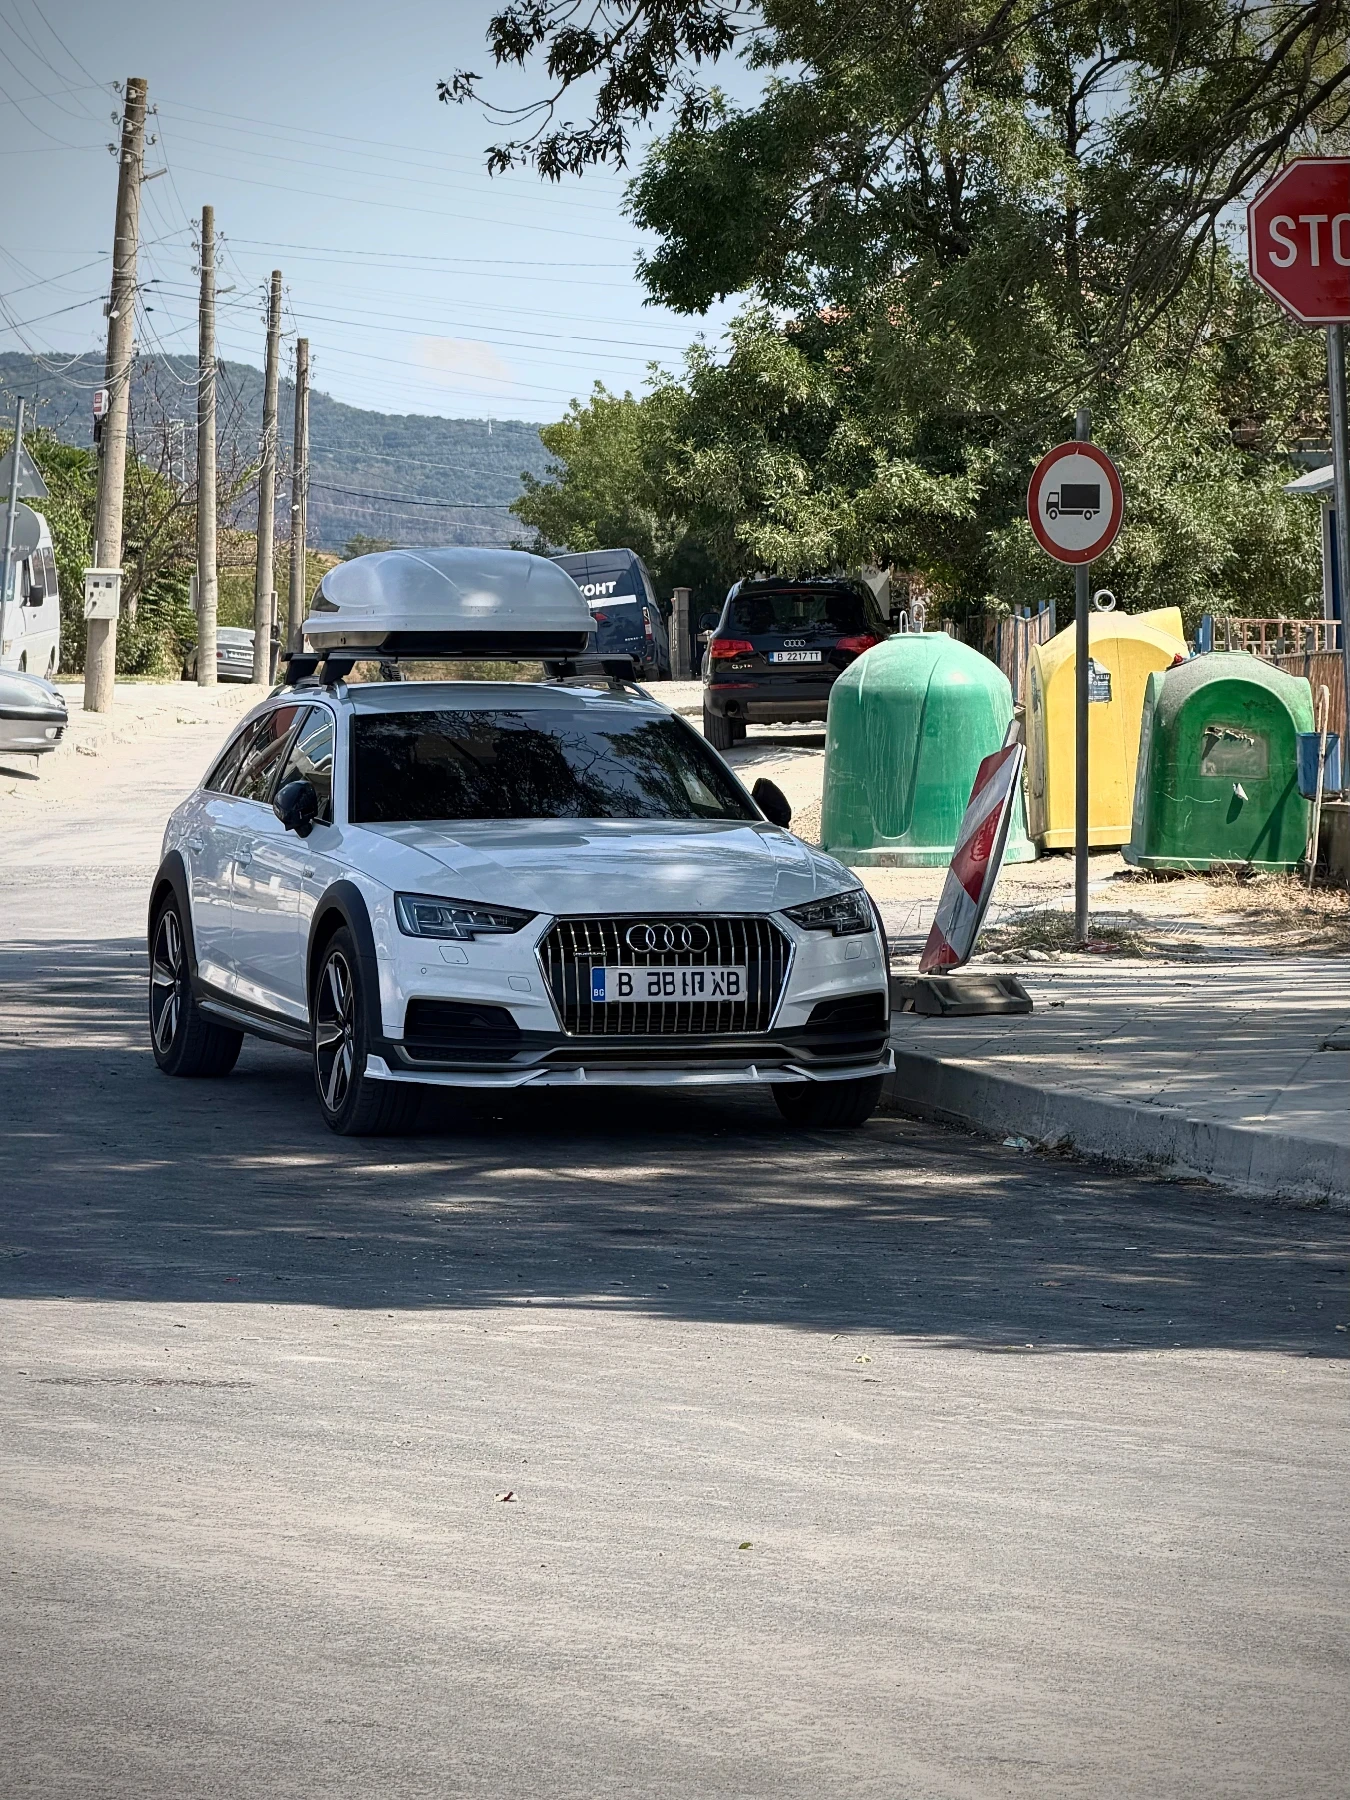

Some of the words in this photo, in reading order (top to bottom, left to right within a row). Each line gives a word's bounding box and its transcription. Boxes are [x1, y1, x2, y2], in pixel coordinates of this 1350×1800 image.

[777, 653, 784, 662] B
[787, 652, 807, 661] 2217
[808, 651, 820, 661] TT
[618, 972, 633, 997] B
[593, 988, 605, 997] BG
